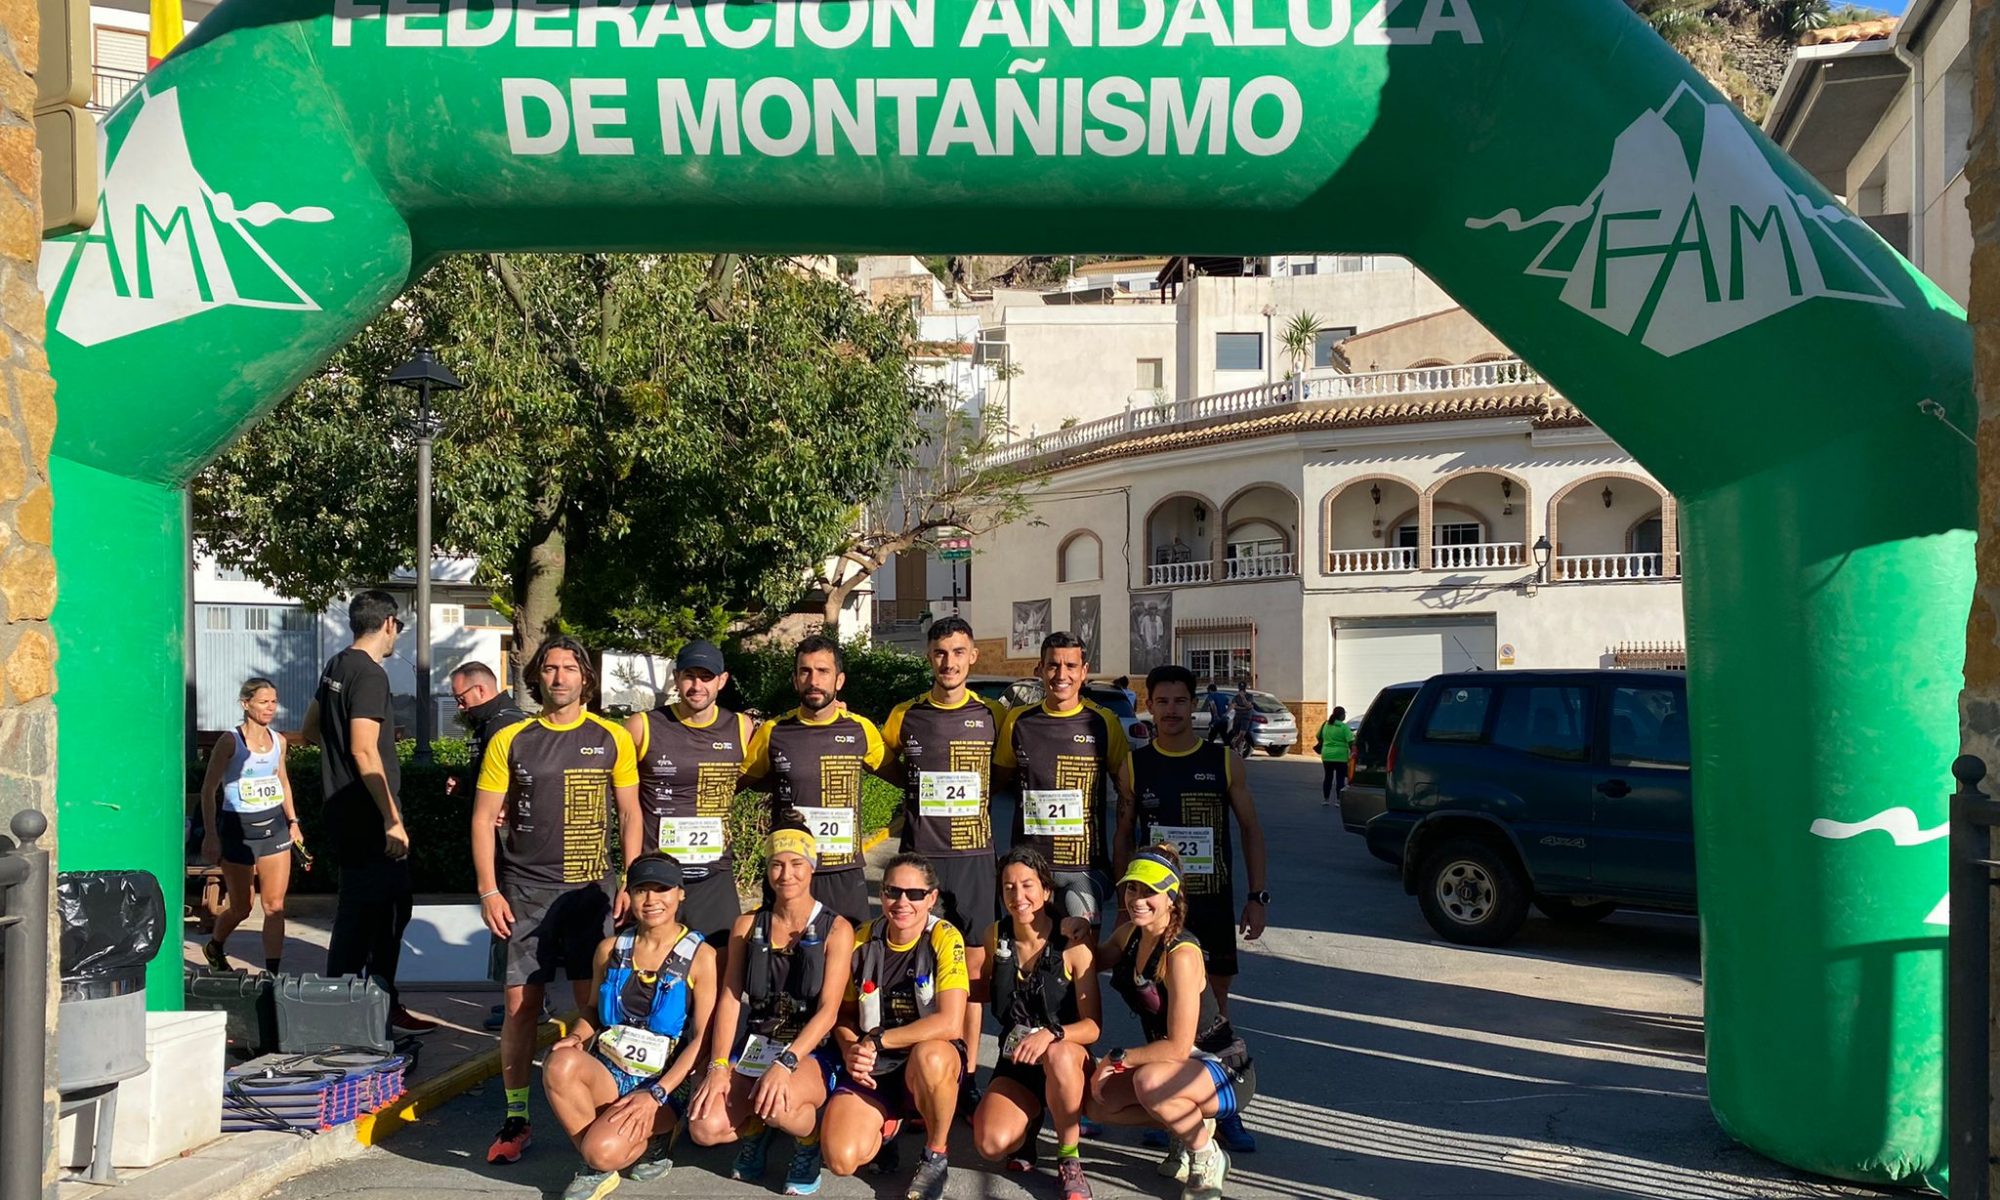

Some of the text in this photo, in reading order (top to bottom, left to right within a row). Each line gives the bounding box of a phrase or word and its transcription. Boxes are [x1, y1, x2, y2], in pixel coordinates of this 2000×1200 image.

[959, 0, 1484, 48] ANDALUZA
[502, 57, 1303, 157] DE MONTAÑISMO
[1590, 192, 1803, 336] FAM
[946, 786, 966, 800] 24
[1048, 804, 1067, 818] 21
[819, 822, 839, 836] 20
[689, 831, 708, 846] 22
[1178, 842, 1198, 856] 23
[624, 1045, 647, 1063] 29
